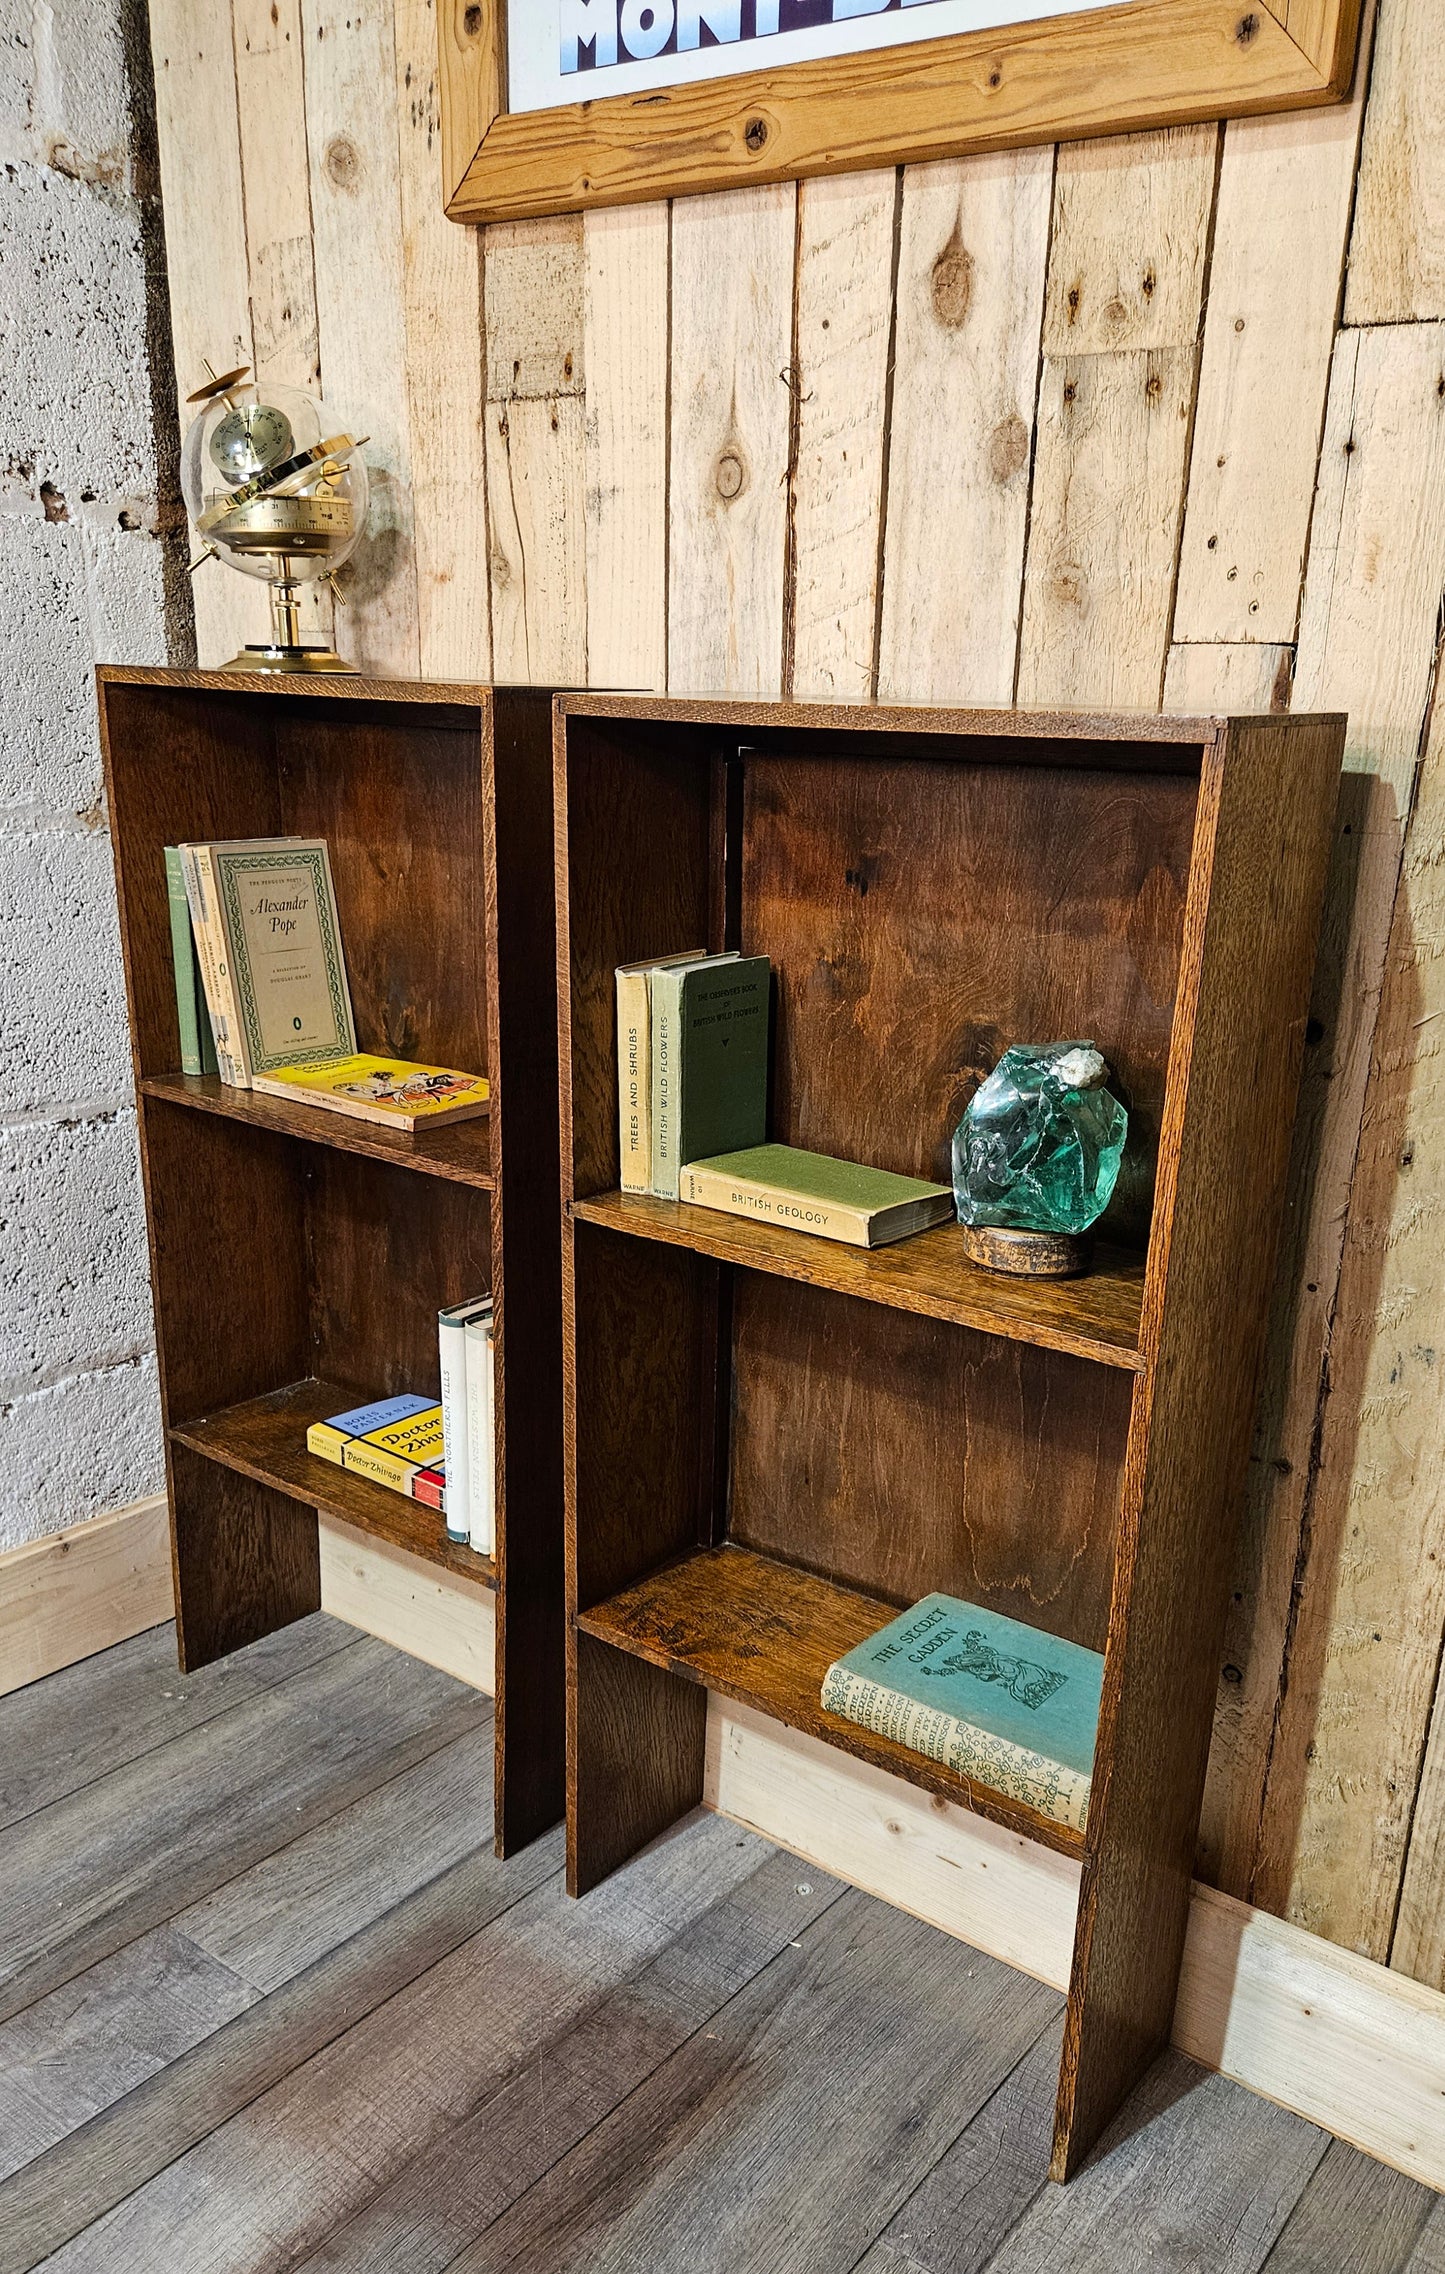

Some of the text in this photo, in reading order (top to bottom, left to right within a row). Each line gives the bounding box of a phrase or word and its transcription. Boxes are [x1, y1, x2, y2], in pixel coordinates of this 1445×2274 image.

[250, 895, 309, 915] Alexander
[269, 917, 297, 935] Pope
[742, 983, 758, 993] BOOK
[629, 1027, 639, 1152] TREES AND SHRUBS
[660, 1016, 668, 1158] BRITISH WILD FLOWERS
[623, 1183, 646, 1191] WARNE
[653, 1188, 674, 1197] WARNE
[731, 1192, 829, 1226] BRITISH GEOLOGY
[443, 1370, 451, 1400] FELLS
[344, 1410, 380, 1426] BORIS
[352, 1402, 420, 1430] PASTERNAK
[382, 1418, 441, 1445] Doctor
[444, 1405, 453, 1464] NORTHERN
[471, 1409, 479, 1462] WESTERN
[346, 1450, 402, 1483] Doctor Zhivago
[472, 1469, 480, 1501] FELLS
[871, 1607, 948, 1665] THE SECRET
[908, 1627, 958, 1663] GARDEN
[850, 1694, 860, 1713] THE
[874, 1706, 882, 1721] BY
[922, 1715, 931, 1731] BY
[927, 1713, 942, 1759] CHARLES
